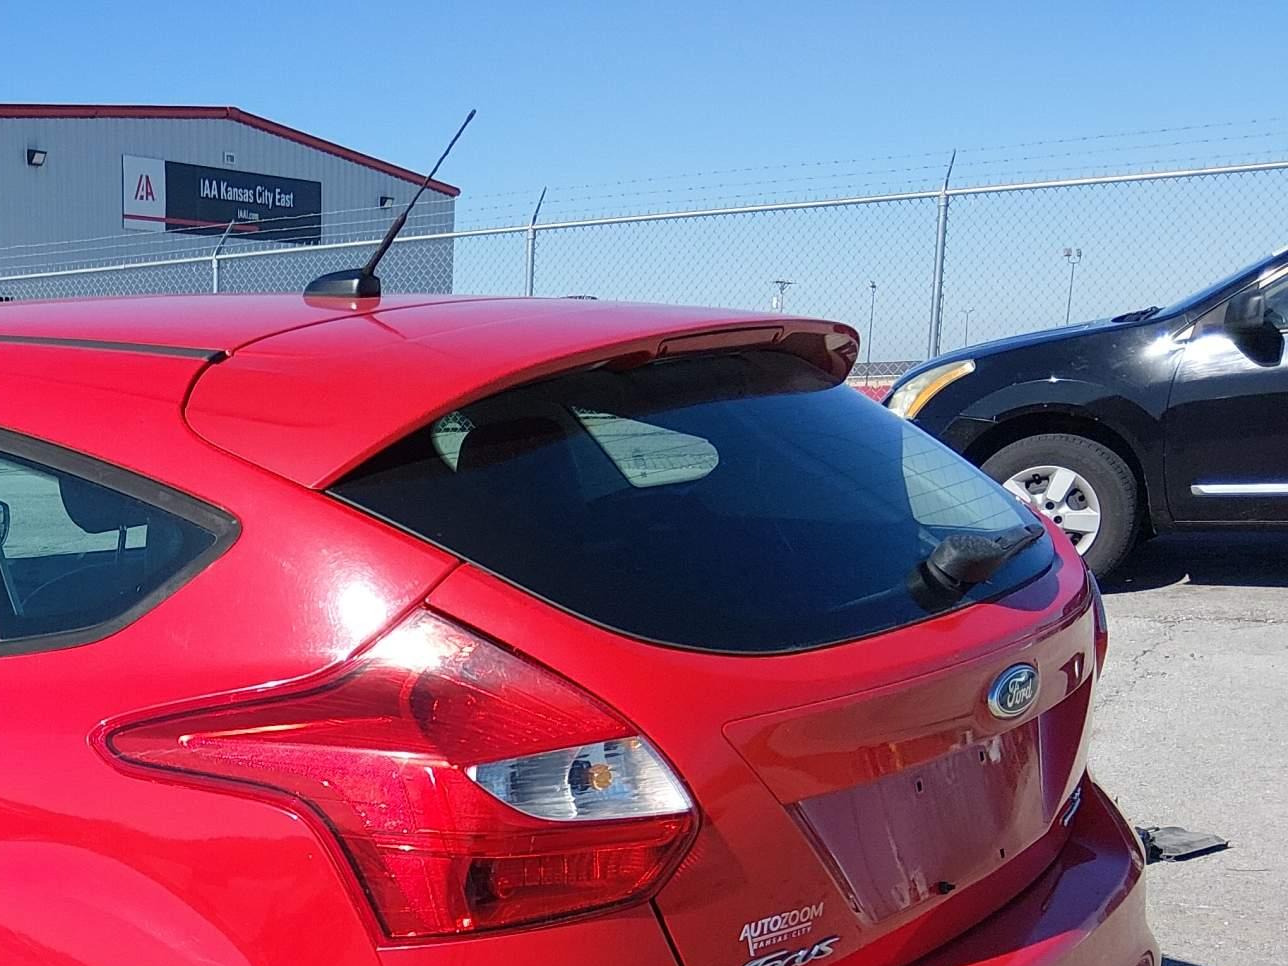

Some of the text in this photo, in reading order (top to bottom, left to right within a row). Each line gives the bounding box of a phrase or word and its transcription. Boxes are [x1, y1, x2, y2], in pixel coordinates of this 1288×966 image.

[200, 178, 294, 209] IAA Kansas City East
[739, 901, 824, 956] AUTOZOOM
[791, 926, 813, 938] CITY
